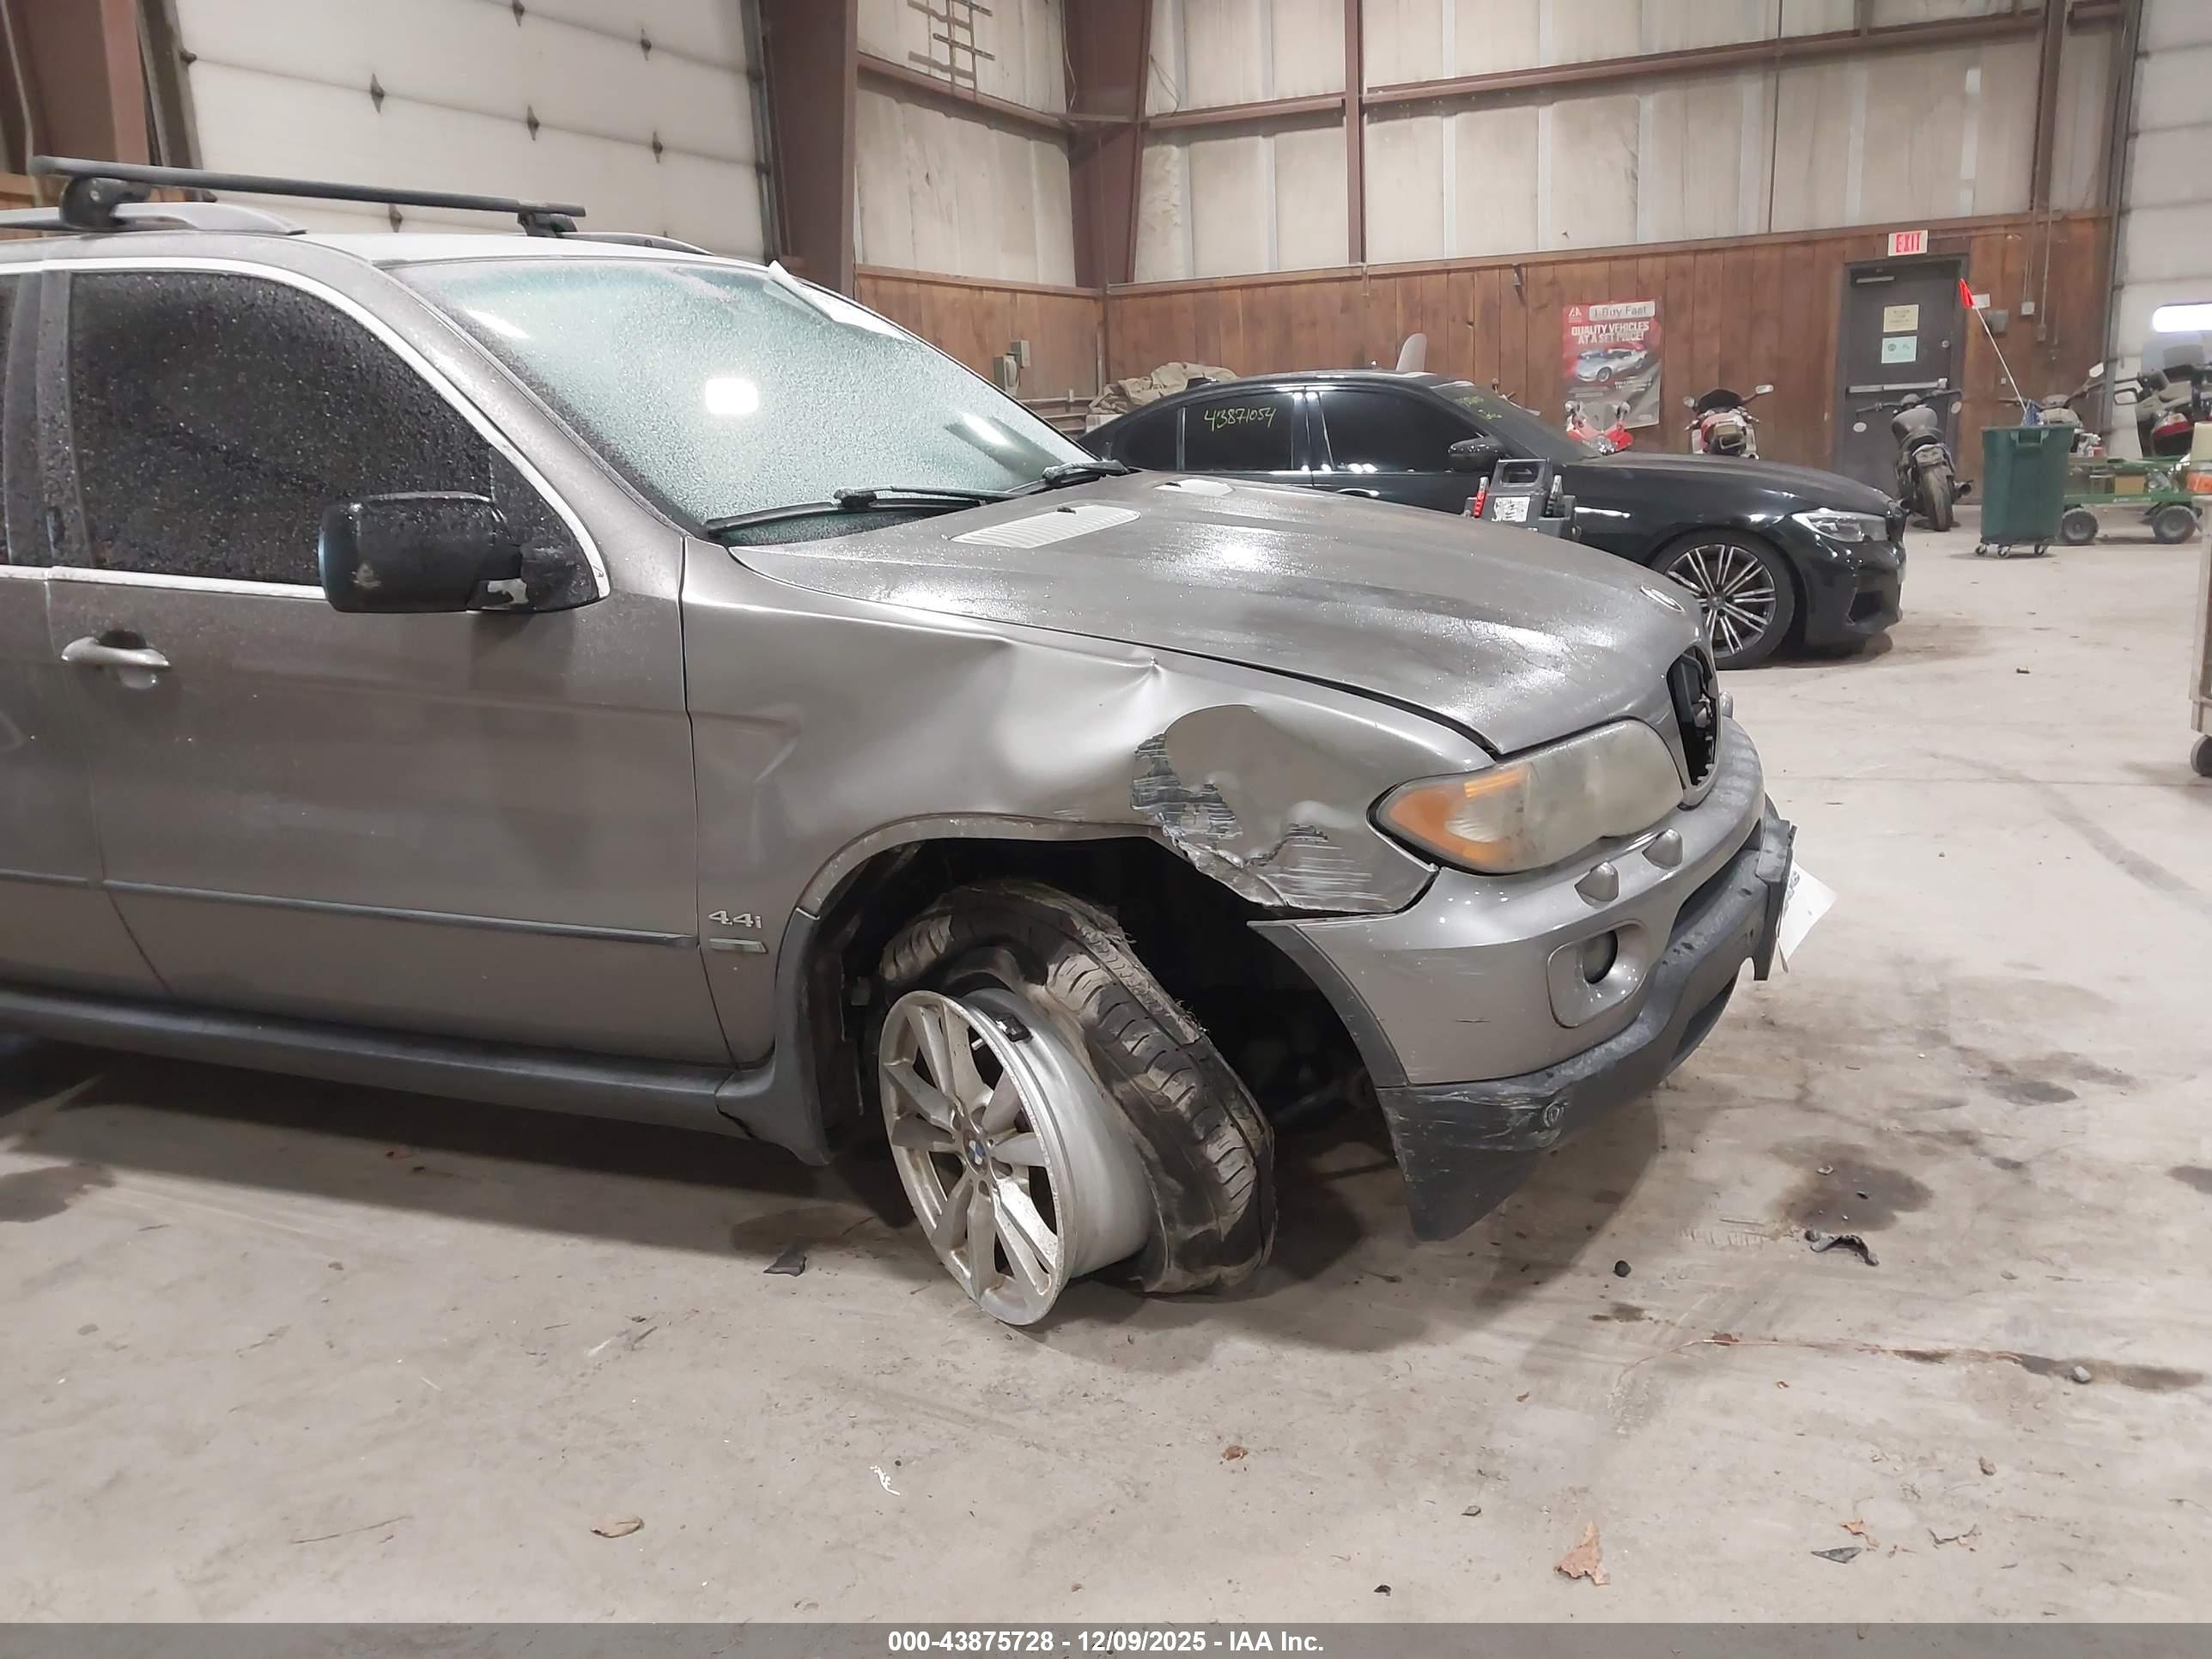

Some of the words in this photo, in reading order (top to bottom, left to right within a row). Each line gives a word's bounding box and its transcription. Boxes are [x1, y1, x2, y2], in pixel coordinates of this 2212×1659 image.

[1896, 233, 1920, 252] EXIT
[1571, 324, 1607, 337] QUALITY
[1608, 321, 1650, 334] VEHICLES
[1578, 334, 1590, 345] AT
[1590, 334, 1598, 344] A
[1599, 332, 1615, 343] SET
[1204, 407, 1277, 432] 43871054
[708, 910, 763, 928] 4.4i
